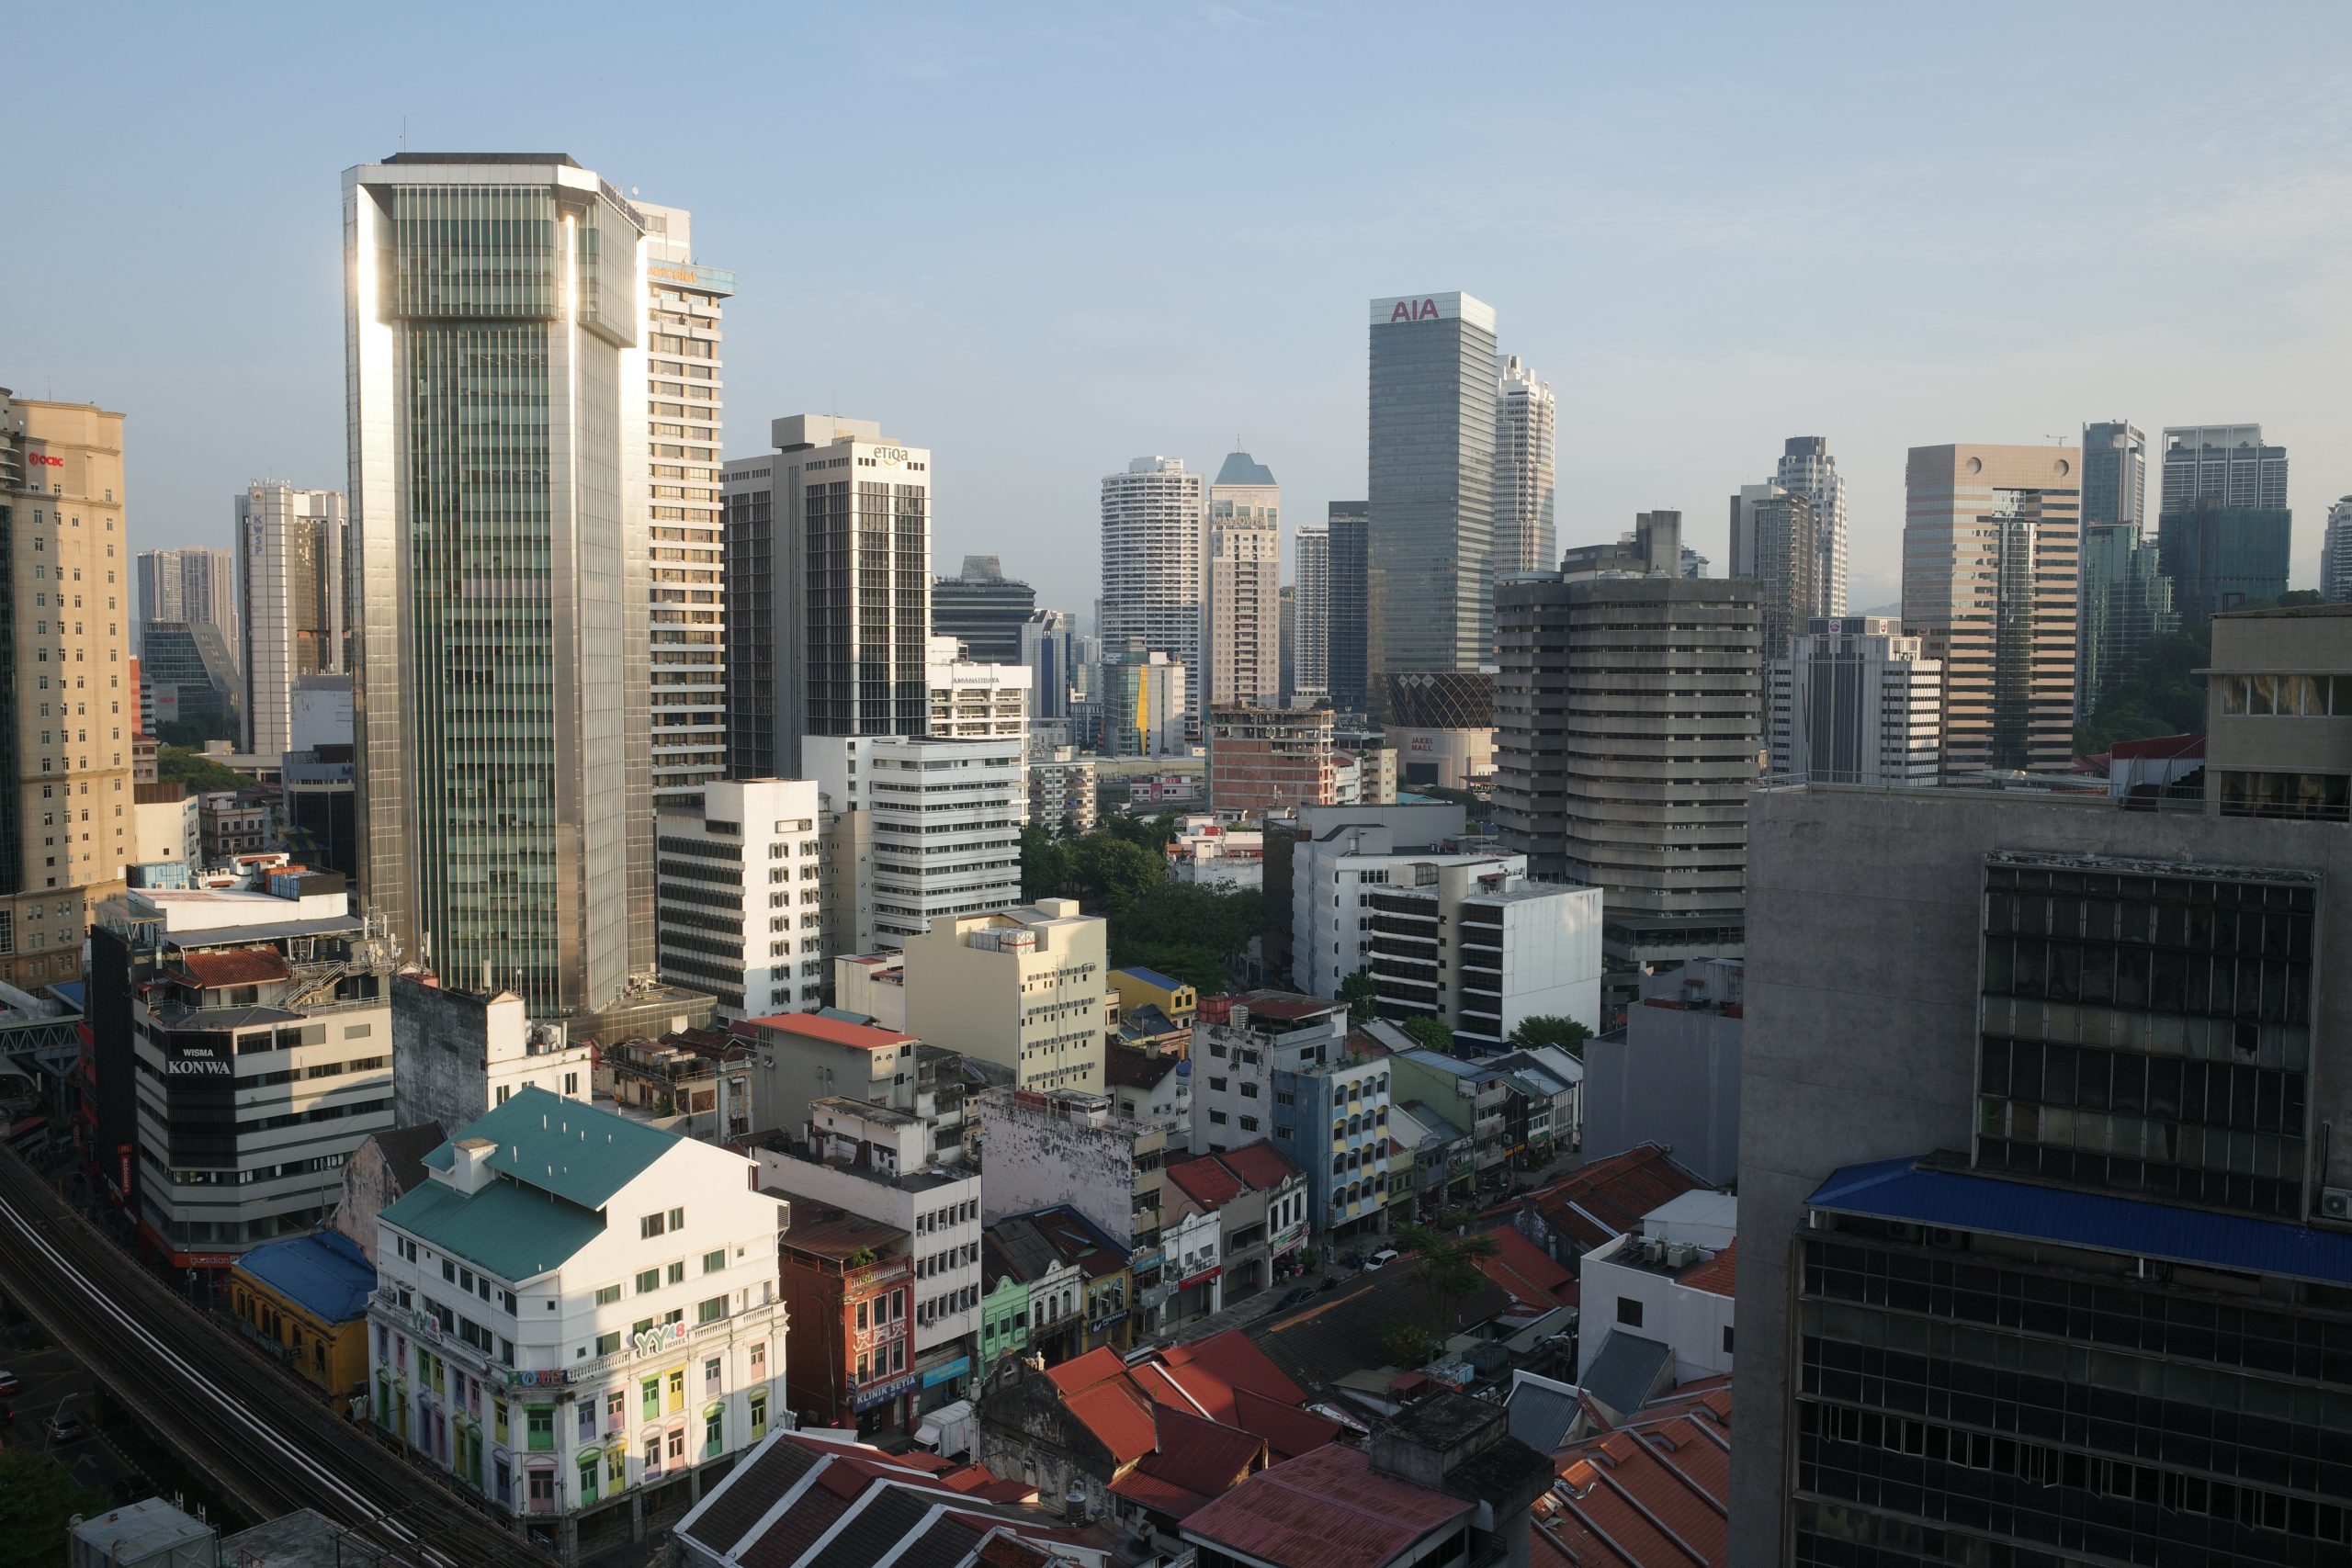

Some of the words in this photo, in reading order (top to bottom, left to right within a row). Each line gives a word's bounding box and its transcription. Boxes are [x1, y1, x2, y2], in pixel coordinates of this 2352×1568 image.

[1391, 299, 1439, 322] AIA
[40, 455, 63, 467] OCBC
[254, 515, 263, 555] KWSP
[183, 1049, 214, 1057] WISMA
[168, 1061, 231, 1074] KONWA
[190, 1255, 230, 1266] guardian
[638, 1322, 685, 1357] YY48
[665, 1337, 685, 1349] HOTEL
[507, 1370, 577, 1386] HOTEL
[857, 1387, 888, 1404] KLINIK
[890, 1376, 917, 1392] SETIA
